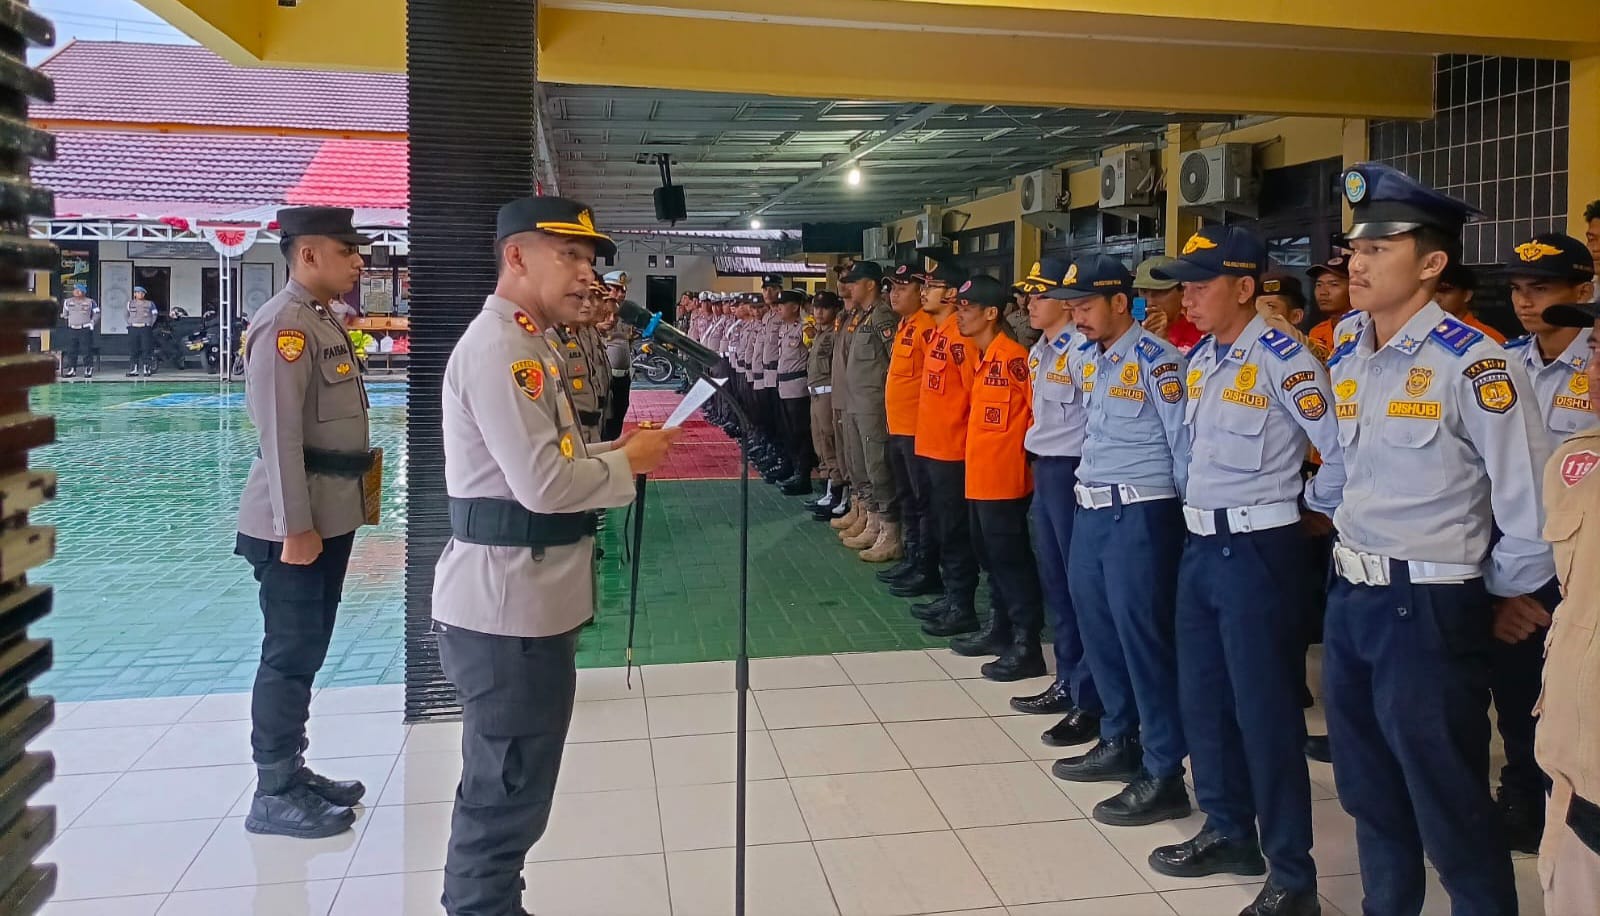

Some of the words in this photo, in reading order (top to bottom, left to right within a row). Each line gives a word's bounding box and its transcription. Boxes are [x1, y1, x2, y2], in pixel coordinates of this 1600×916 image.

[323, 345, 348, 359] FAISAL
[1224, 390, 1264, 406] DISHUB
[1389, 402, 1436, 416] DISHUB
[1565, 460, 1593, 475] 119
